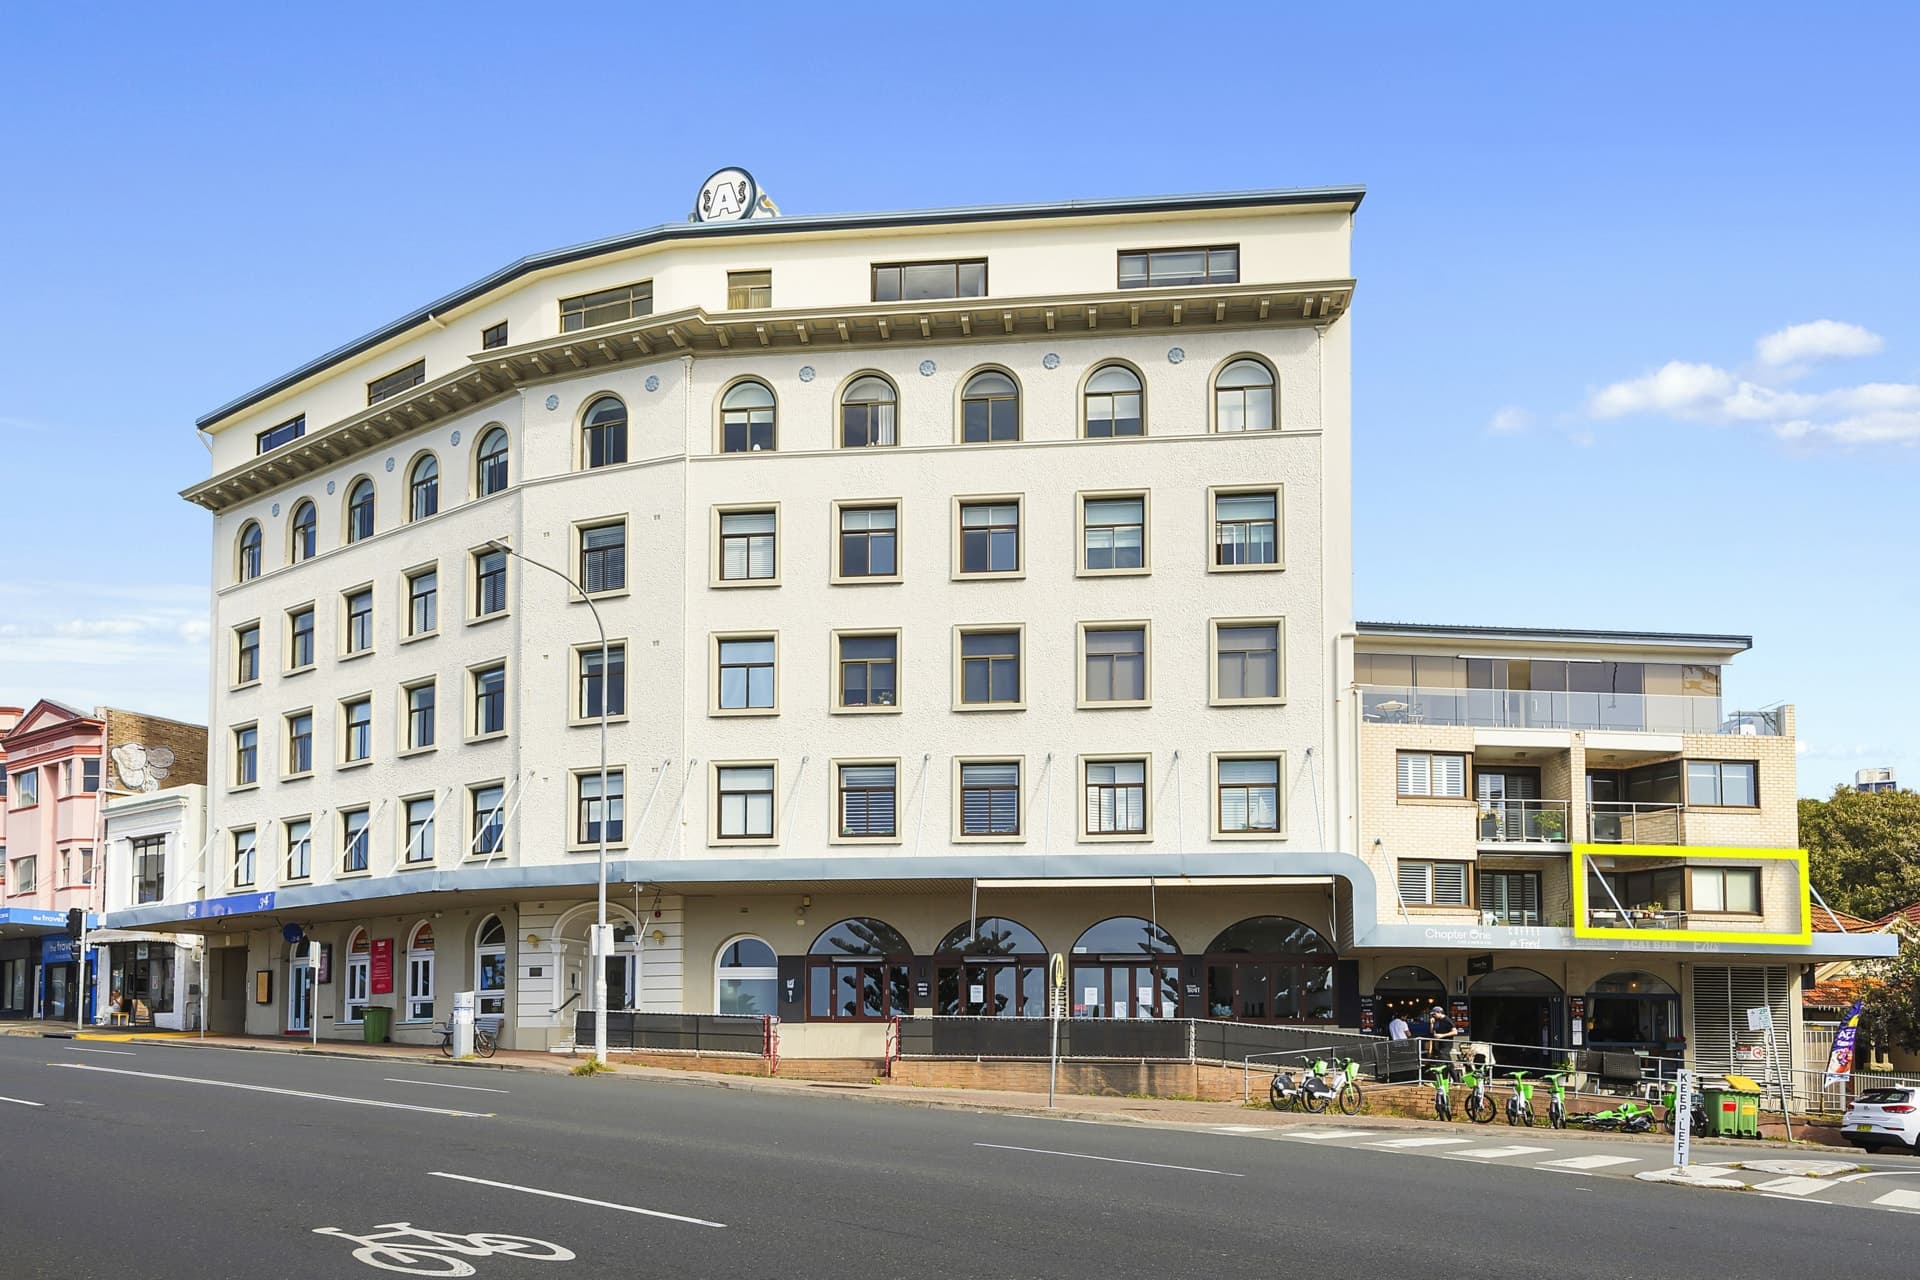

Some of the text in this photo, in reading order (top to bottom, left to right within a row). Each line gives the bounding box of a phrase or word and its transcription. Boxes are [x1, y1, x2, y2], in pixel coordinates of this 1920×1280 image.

[1425, 928, 1492, 942] Chapter One
[1678, 1073, 1688, 1165] KEEP LEFT
